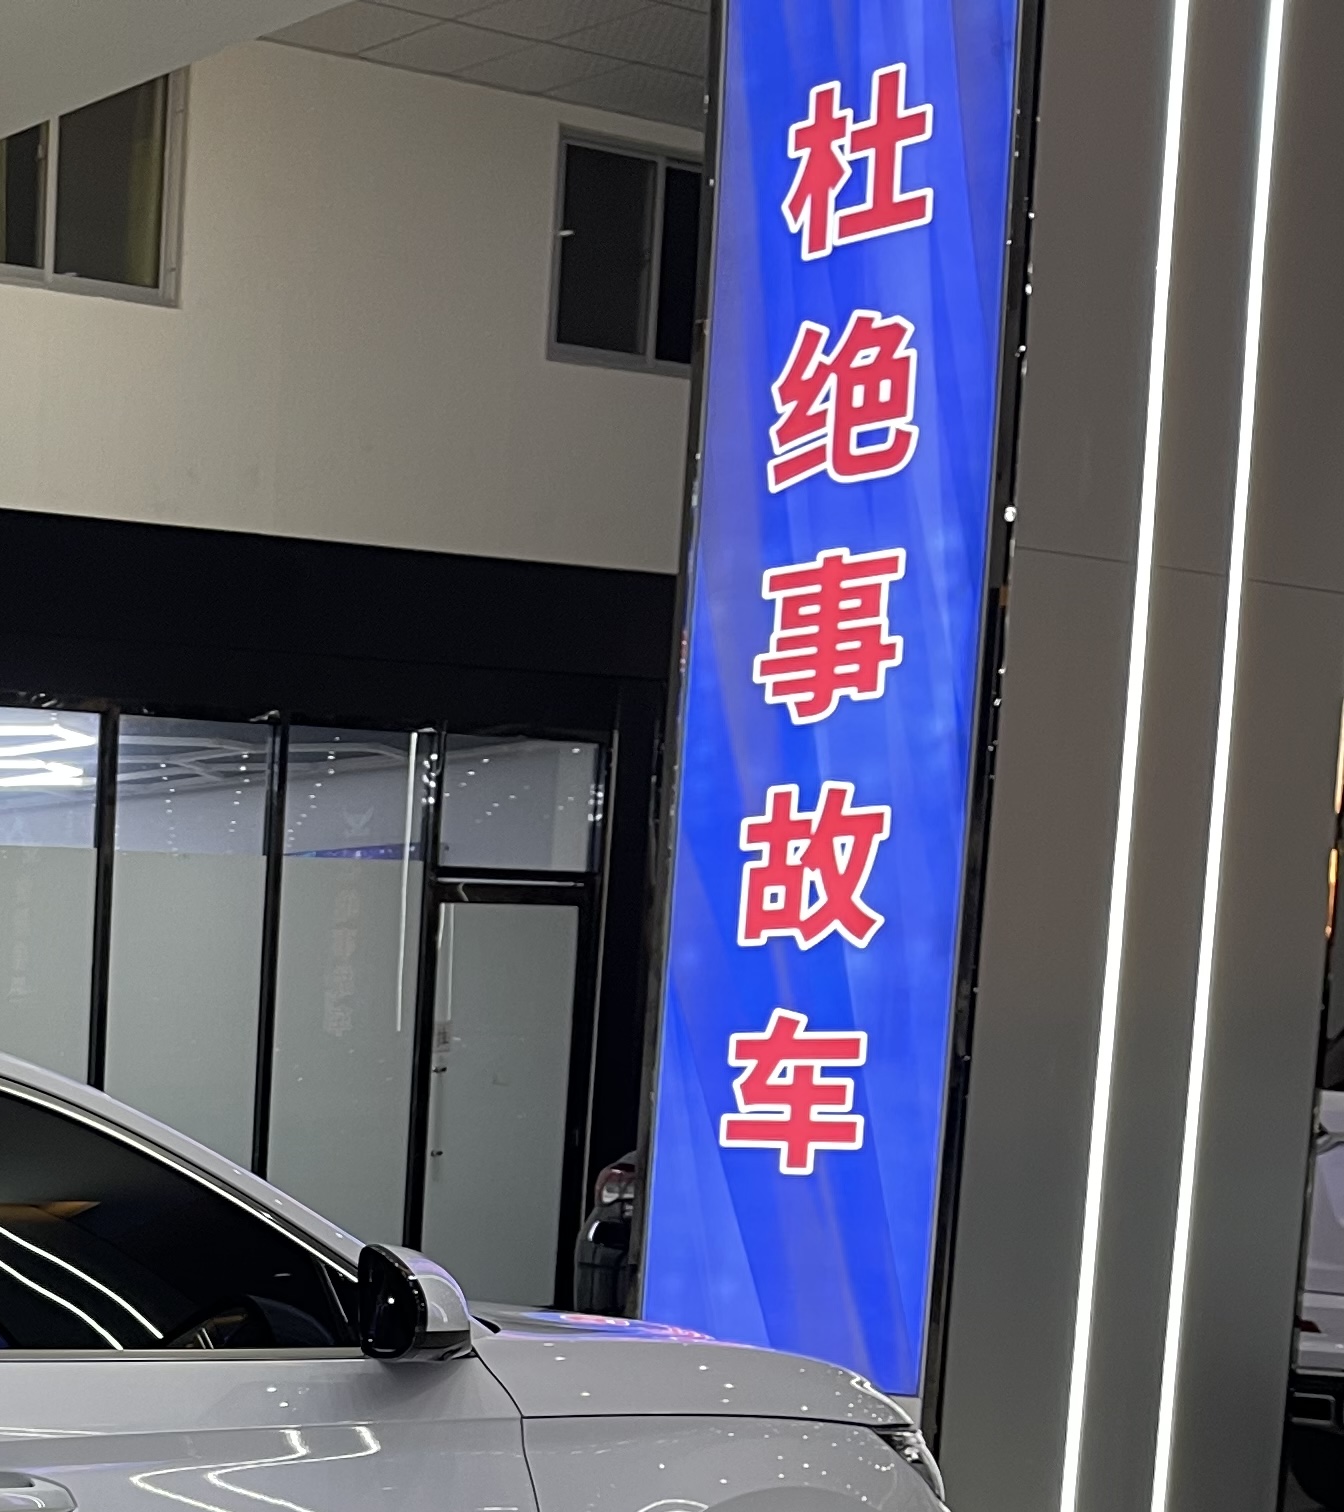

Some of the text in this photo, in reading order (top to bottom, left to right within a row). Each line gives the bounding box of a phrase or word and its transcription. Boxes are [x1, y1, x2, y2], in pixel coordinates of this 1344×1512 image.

[719, 62, 934, 1176] 杜绝事故车
